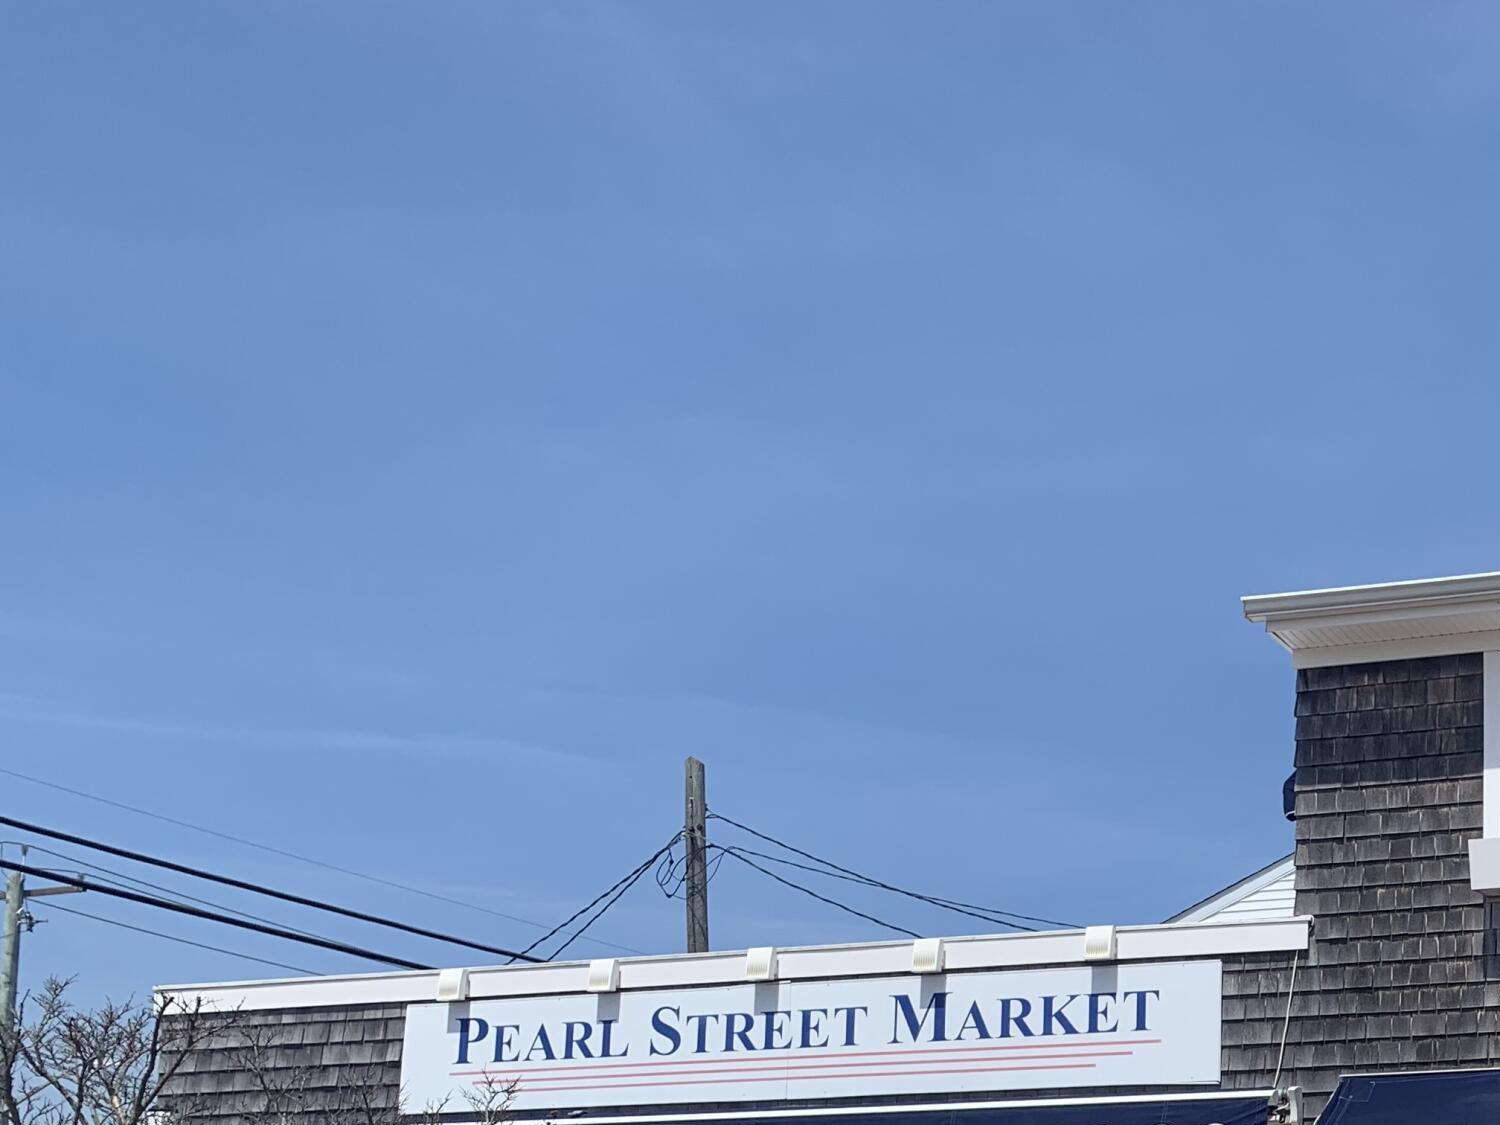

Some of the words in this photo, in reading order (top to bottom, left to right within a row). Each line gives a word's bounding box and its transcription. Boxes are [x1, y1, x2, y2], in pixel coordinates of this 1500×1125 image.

[453, 1017, 629, 1064] PEARL
[649, 1005, 868, 1056] STREET
[887, 990, 1160, 1045] MARKET
